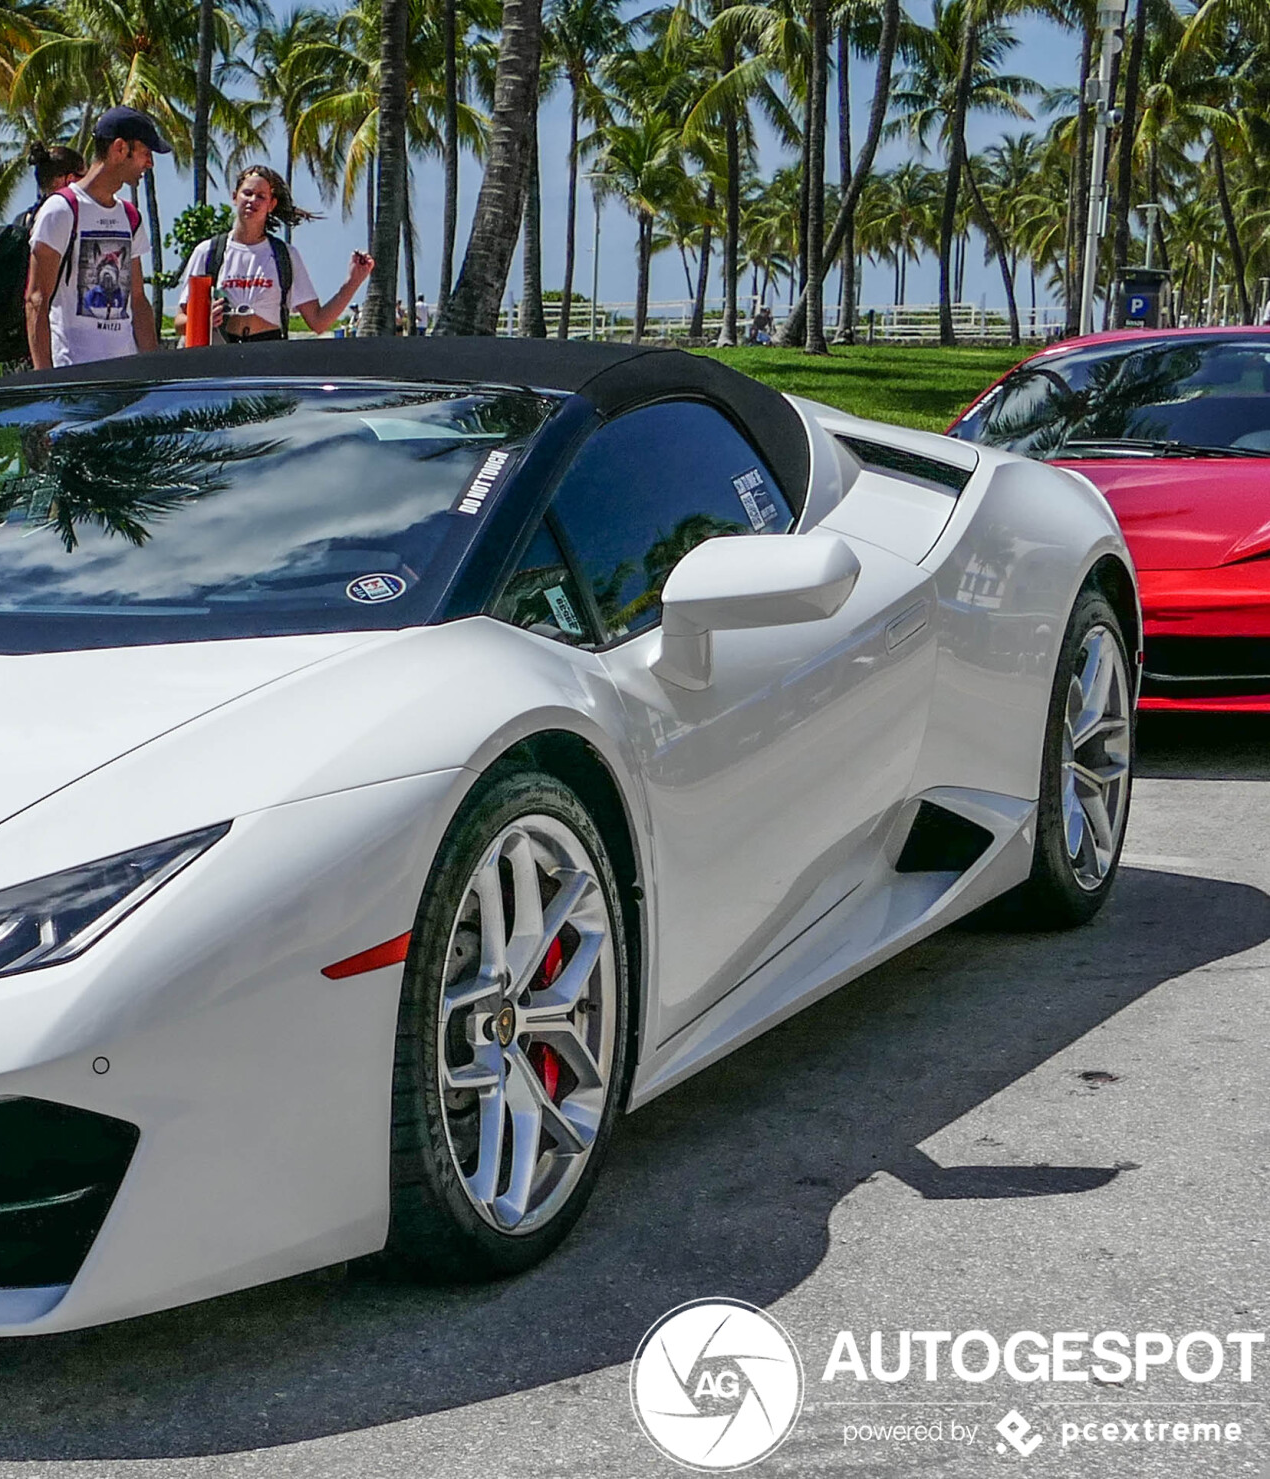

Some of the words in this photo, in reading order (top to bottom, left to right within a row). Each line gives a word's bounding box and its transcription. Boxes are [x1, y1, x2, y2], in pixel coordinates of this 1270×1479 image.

[1131, 298, 1144, 314] P
[477, 450, 510, 480] TOUCH
[466, 479, 492, 501] NOT
[458, 498, 482, 515] DO
[352, 586, 366, 599] VIP
